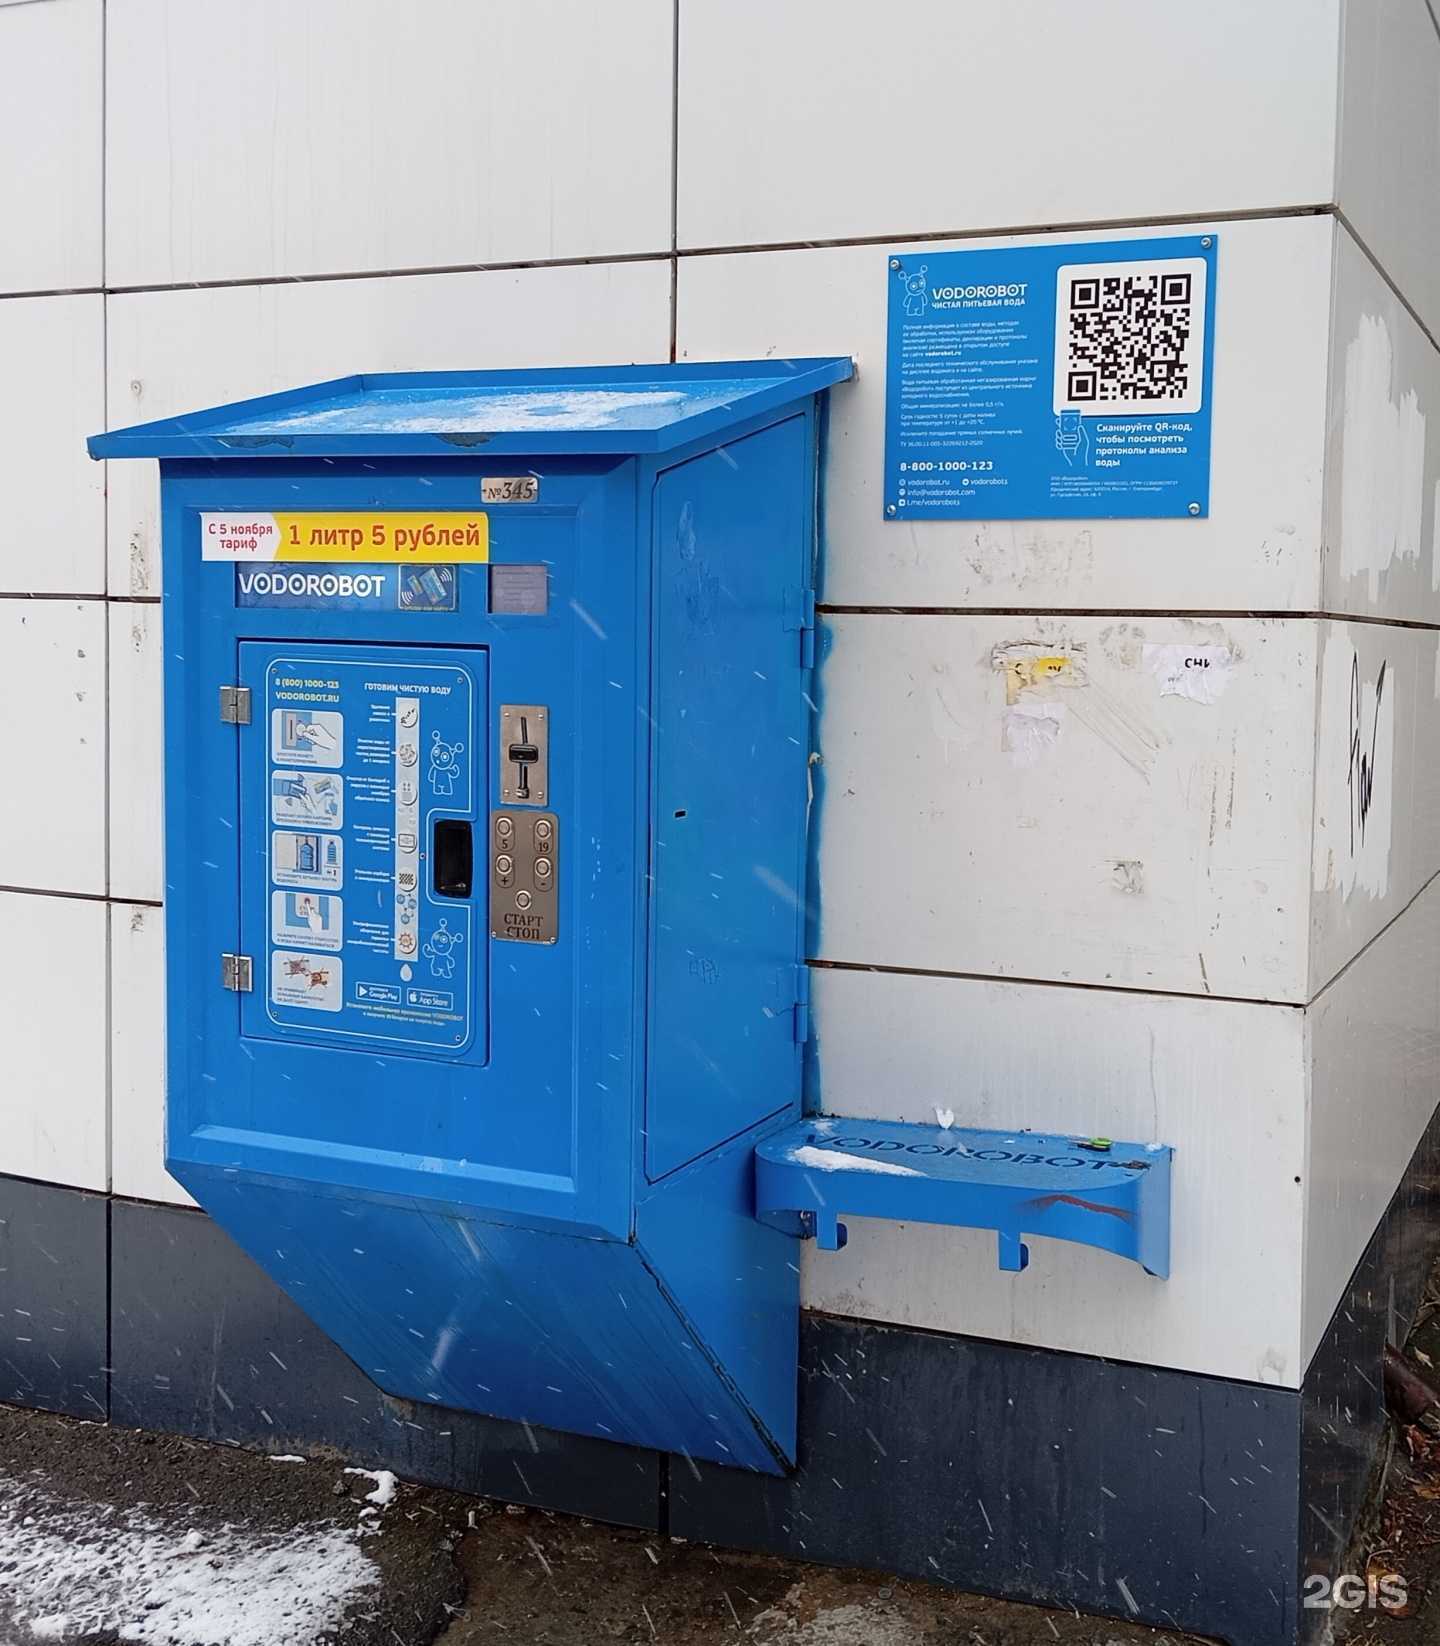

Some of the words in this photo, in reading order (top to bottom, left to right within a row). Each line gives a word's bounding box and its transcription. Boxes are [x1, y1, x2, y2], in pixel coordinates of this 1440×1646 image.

[932, 284, 1028, 300] VODOROBOT
[931, 301, 961, 309] ЧИСТАЯ
[963, 299, 1002, 308] ПИТЬЕВАЯ
[1003, 298, 1026, 306] ВОДА
[1096, 423, 1153, 433] Сканируйте
[1154, 422, 1193, 433] QR-код,
[1096, 435, 1126, 444] чтобы
[1127, 435, 1184, 444] посмотреть
[1096, 447, 1147, 456] протоколы
[1149, 446, 1187, 454] анализа
[900, 461, 993, 471] 8-800-1000-123
[1096, 459, 1121, 468] воды
[907, 479, 950, 487] vodorobot.ru
[208, 523, 217, 535] С
[220, 523, 228, 535] 5
[230, 523, 273, 537] ноября
[289, 524, 301, 545] 1
[309, 528, 363, 551] литр
[372, 524, 386, 546] 5
[394, 522, 480, 551] рублей
[220, 537, 258, 551] тариф
[238, 572, 386, 597] VODOROBOT
[365, 682, 398, 692] ГОТОВИМ
[399, 684, 429, 694] ЧИСТУЮ
[430, 686, 451, 696] ВОДУ
[275, 691, 340, 703] VODOROBOT.RU
[501, 839, 508, 849] 5
[538, 842, 549, 853] 19
[504, 912, 544, 928] СТАРТ
[506, 926, 541, 940] СТОП
[804, 1134, 1122, 1170] VODOROBOT
